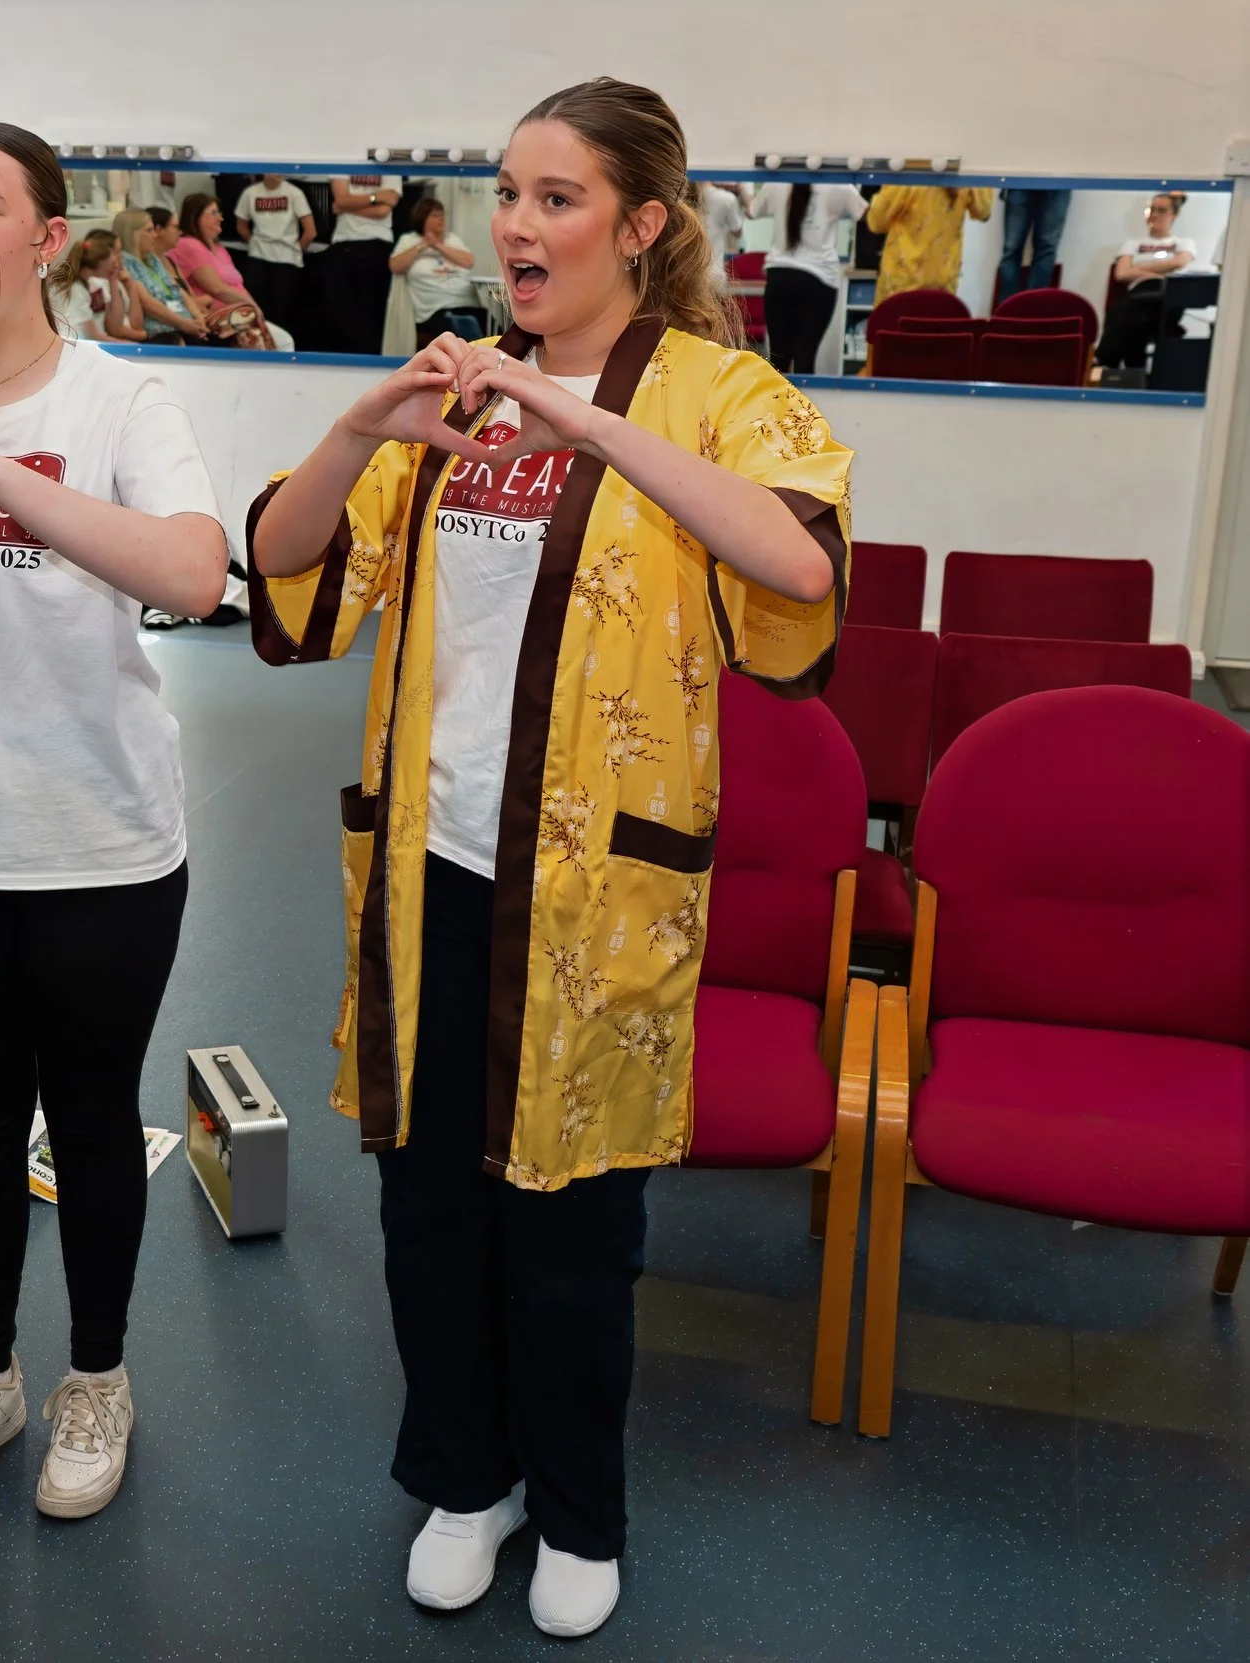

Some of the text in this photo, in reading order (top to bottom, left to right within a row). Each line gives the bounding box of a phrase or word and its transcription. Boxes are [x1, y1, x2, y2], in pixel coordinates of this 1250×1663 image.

[490, 429, 508, 442] WE
[449, 445, 574, 496] GREA
[442, 488, 553, 514] 19 THE MUSICA
